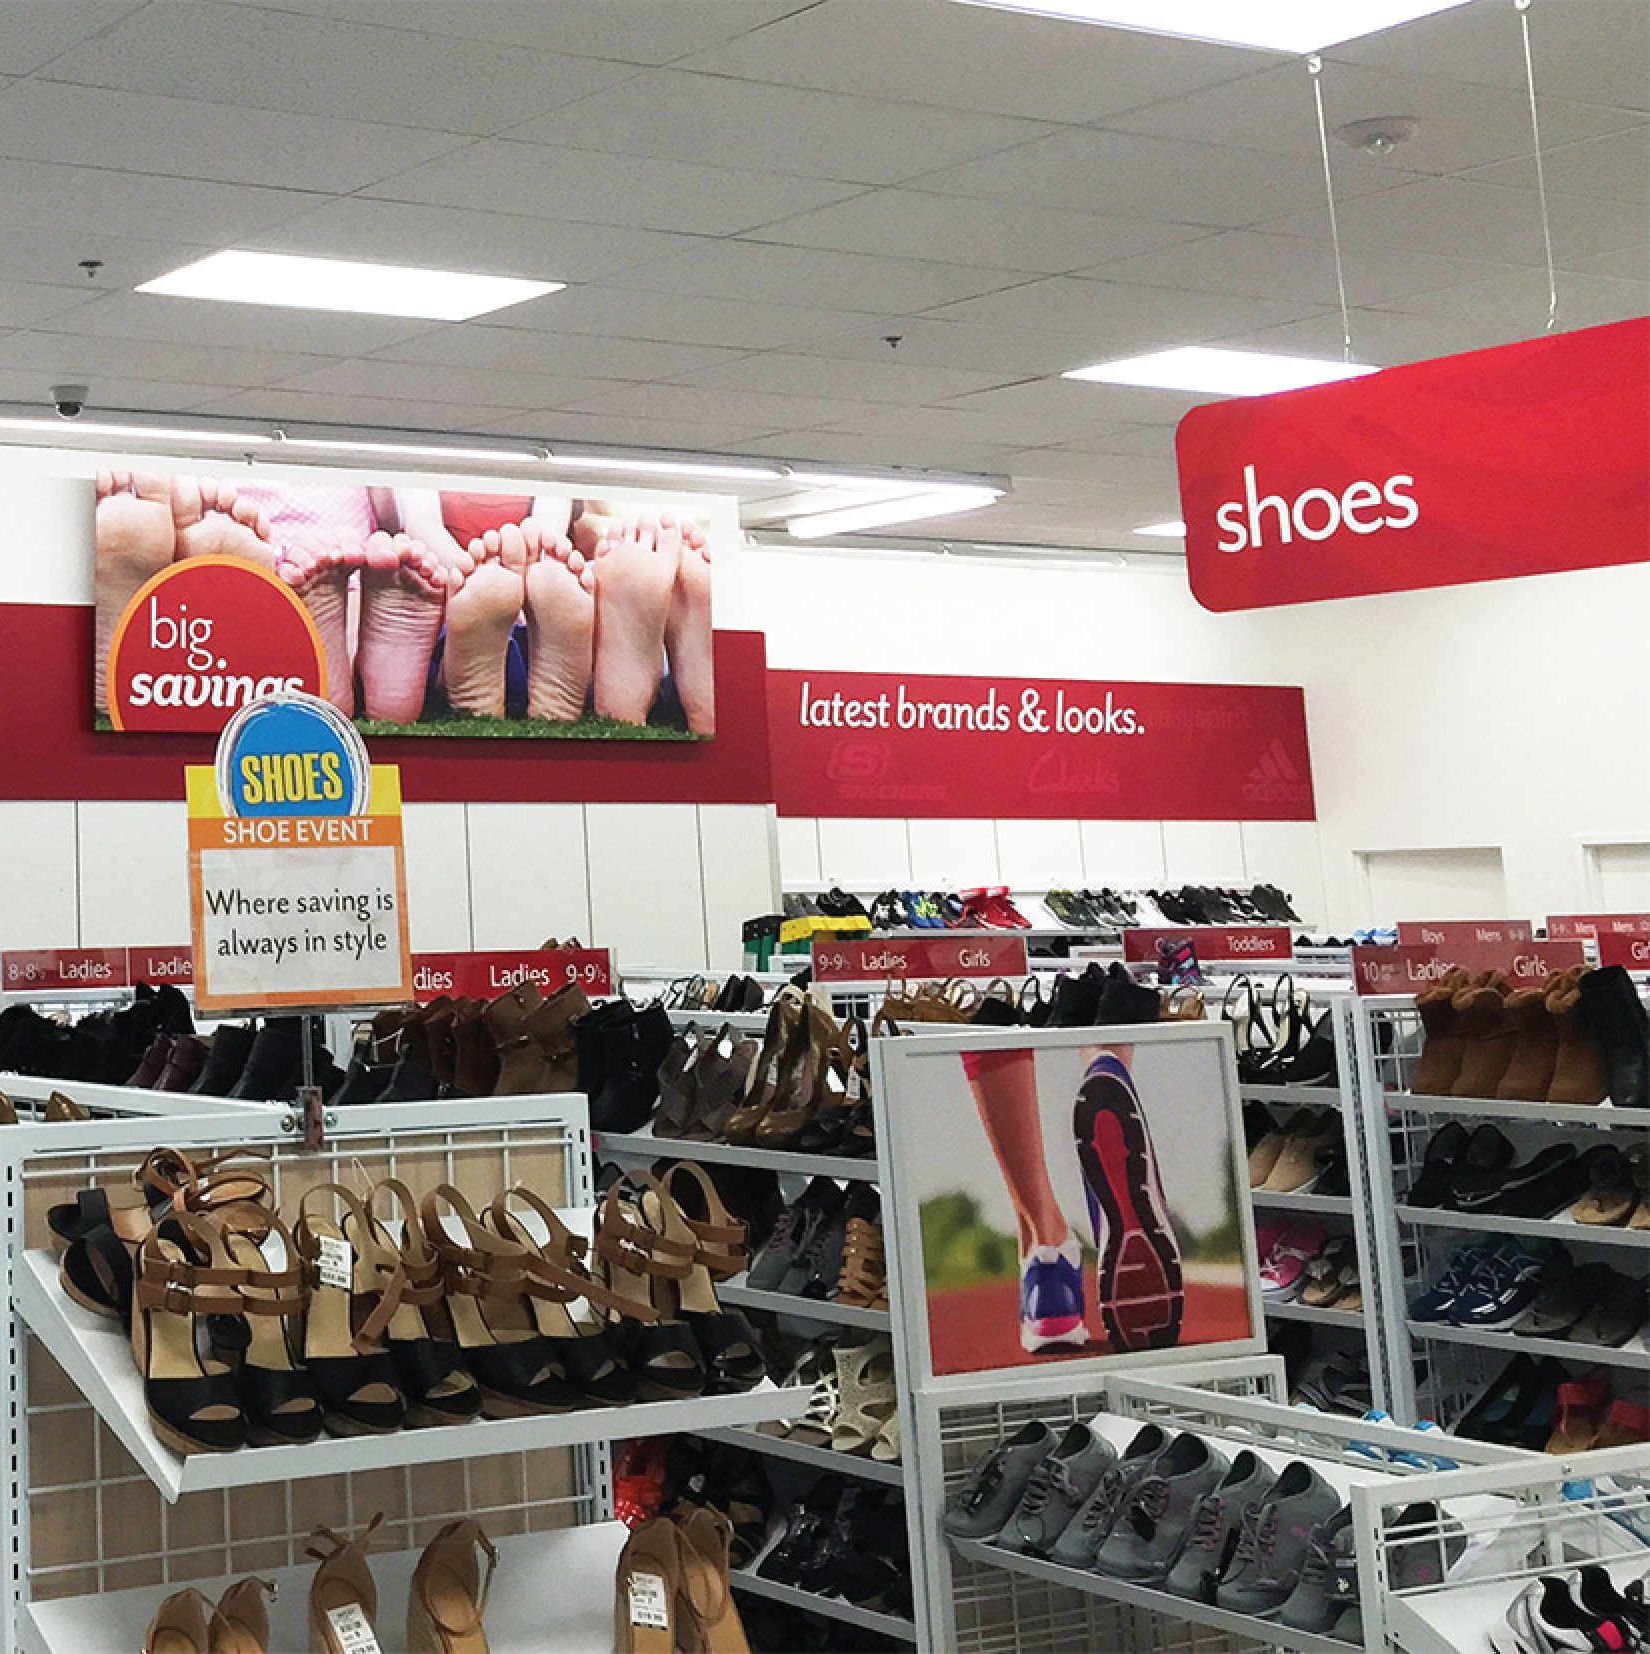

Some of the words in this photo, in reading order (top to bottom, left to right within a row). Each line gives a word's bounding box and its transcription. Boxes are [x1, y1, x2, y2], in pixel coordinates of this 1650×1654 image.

[1215, 464, 1420, 554] shoes
[149, 596, 214, 671] big
[799, 682, 891, 729] latest
[896, 685, 1011, 732] brands
[1017, 688, 1050, 734] &
[1055, 690, 1146, 736] looks.
[240, 752, 344, 805] SHOES
[223, 821, 291, 844] SHOE
[295, 819, 373, 843] EVENT
[205, 889, 290, 916] Where
[296, 888, 371, 922] saving
[375, 887, 394, 912] is
[218, 929, 299, 964] always
[304, 928, 328, 953] in
[333, 925, 388, 961] style
[59, 959, 113, 979] Ladies
[147, 956, 193, 977] Ladie
